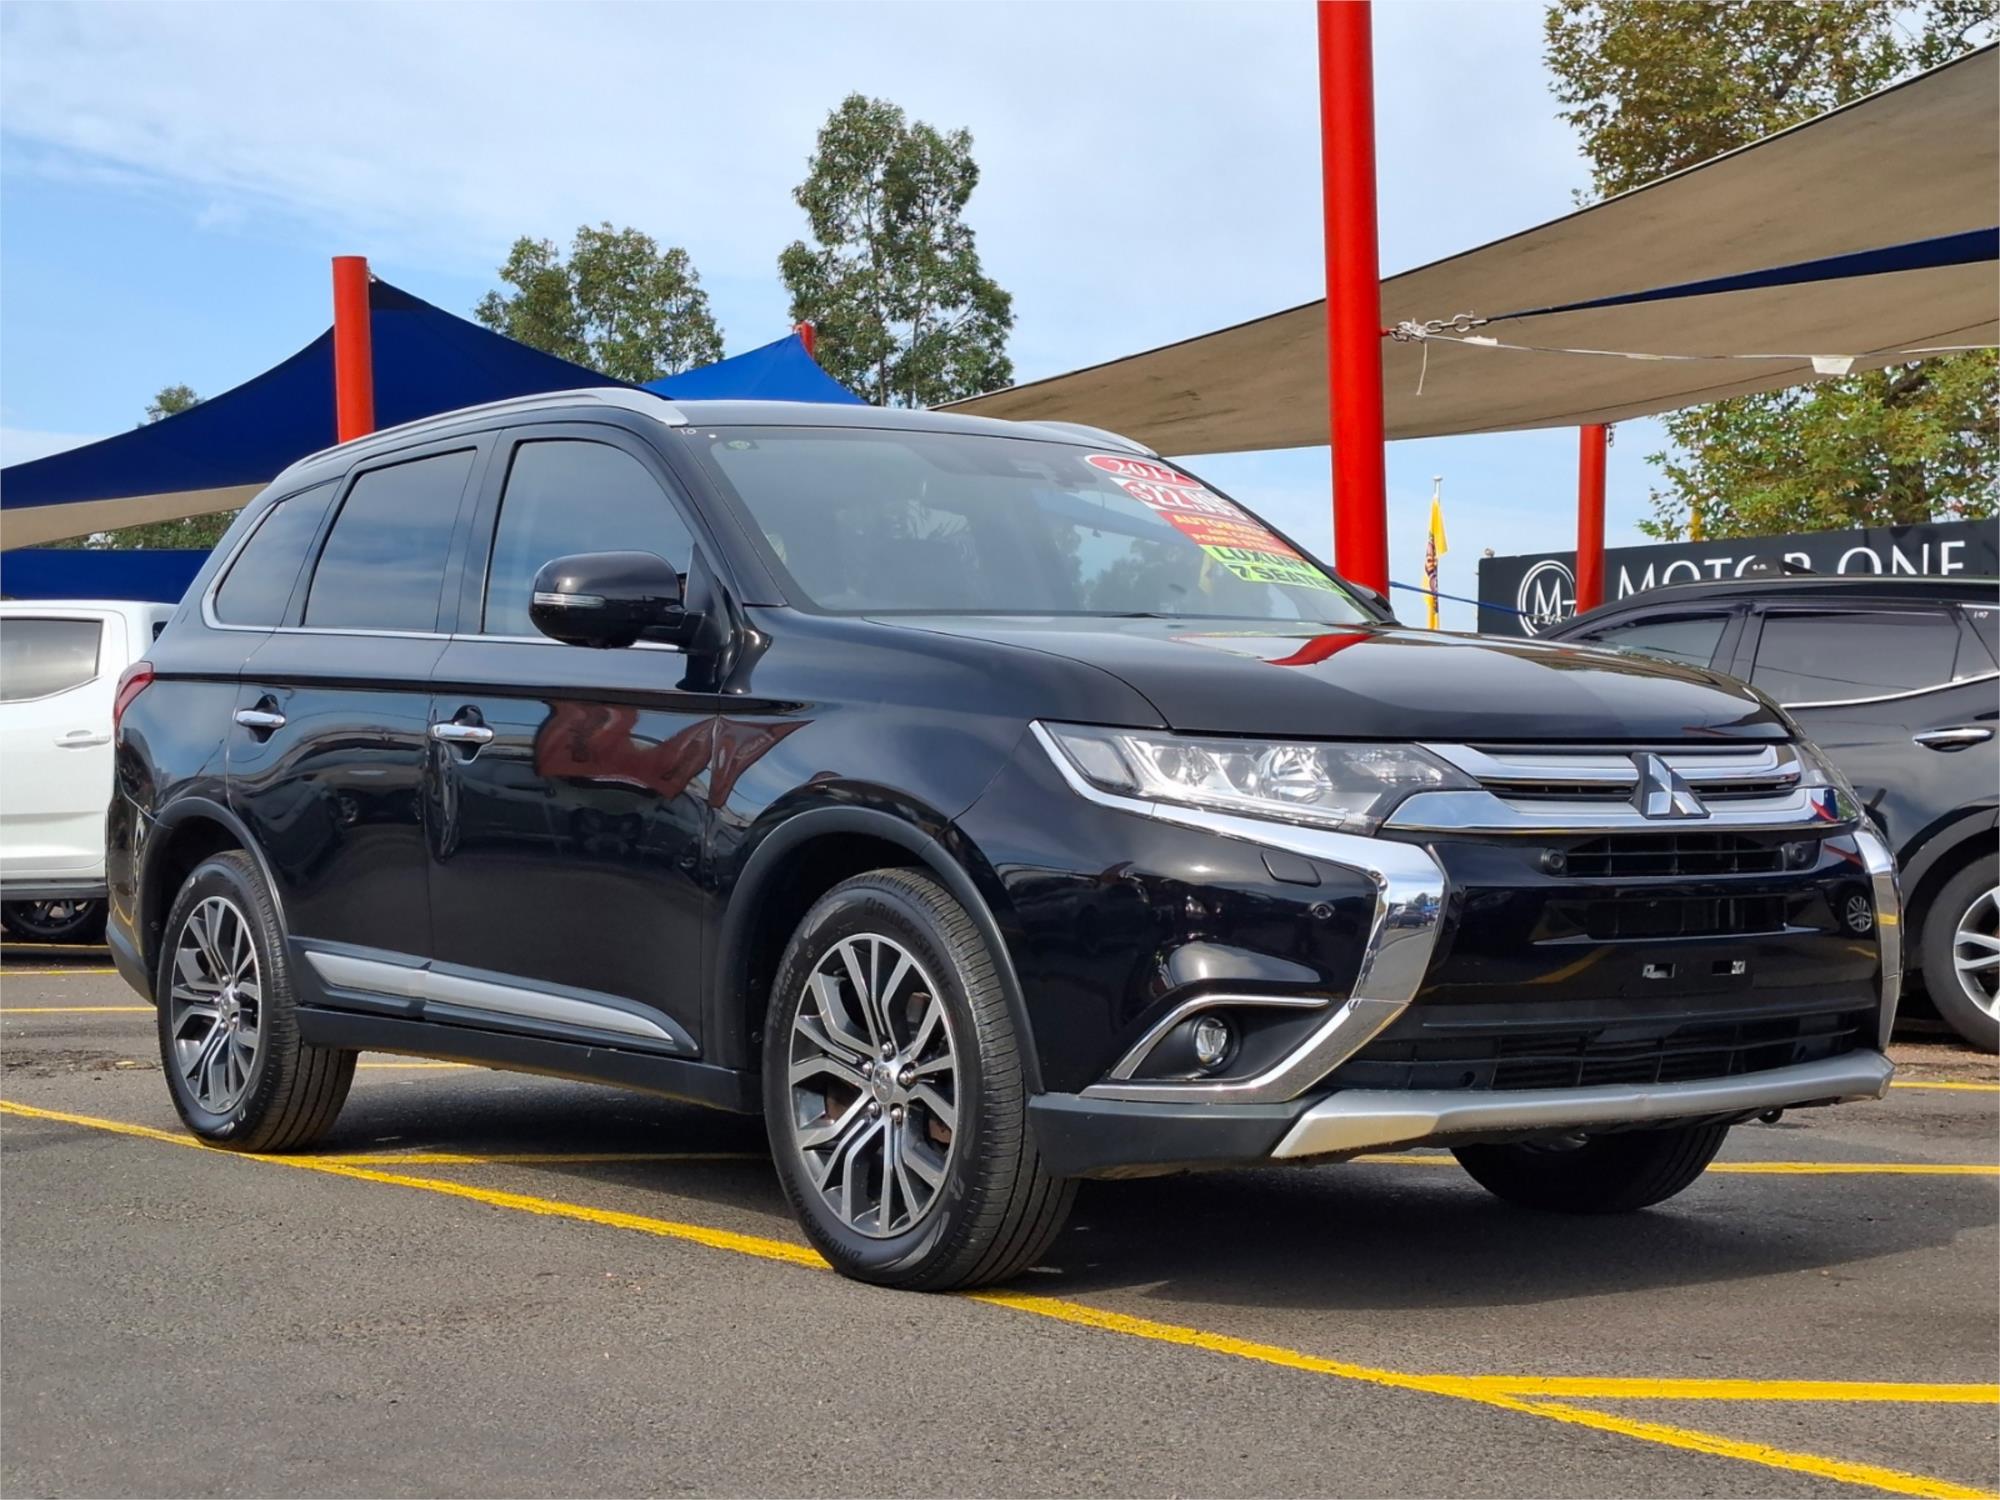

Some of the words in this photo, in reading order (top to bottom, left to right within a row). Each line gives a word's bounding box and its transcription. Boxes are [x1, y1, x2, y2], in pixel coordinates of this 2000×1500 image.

[1107, 459, 1178, 483] 2017
[1212, 546, 1313, 574] LUXURY
[1227, 564, 1248, 579] 7
[1617, 552, 1812, 601] MOT
